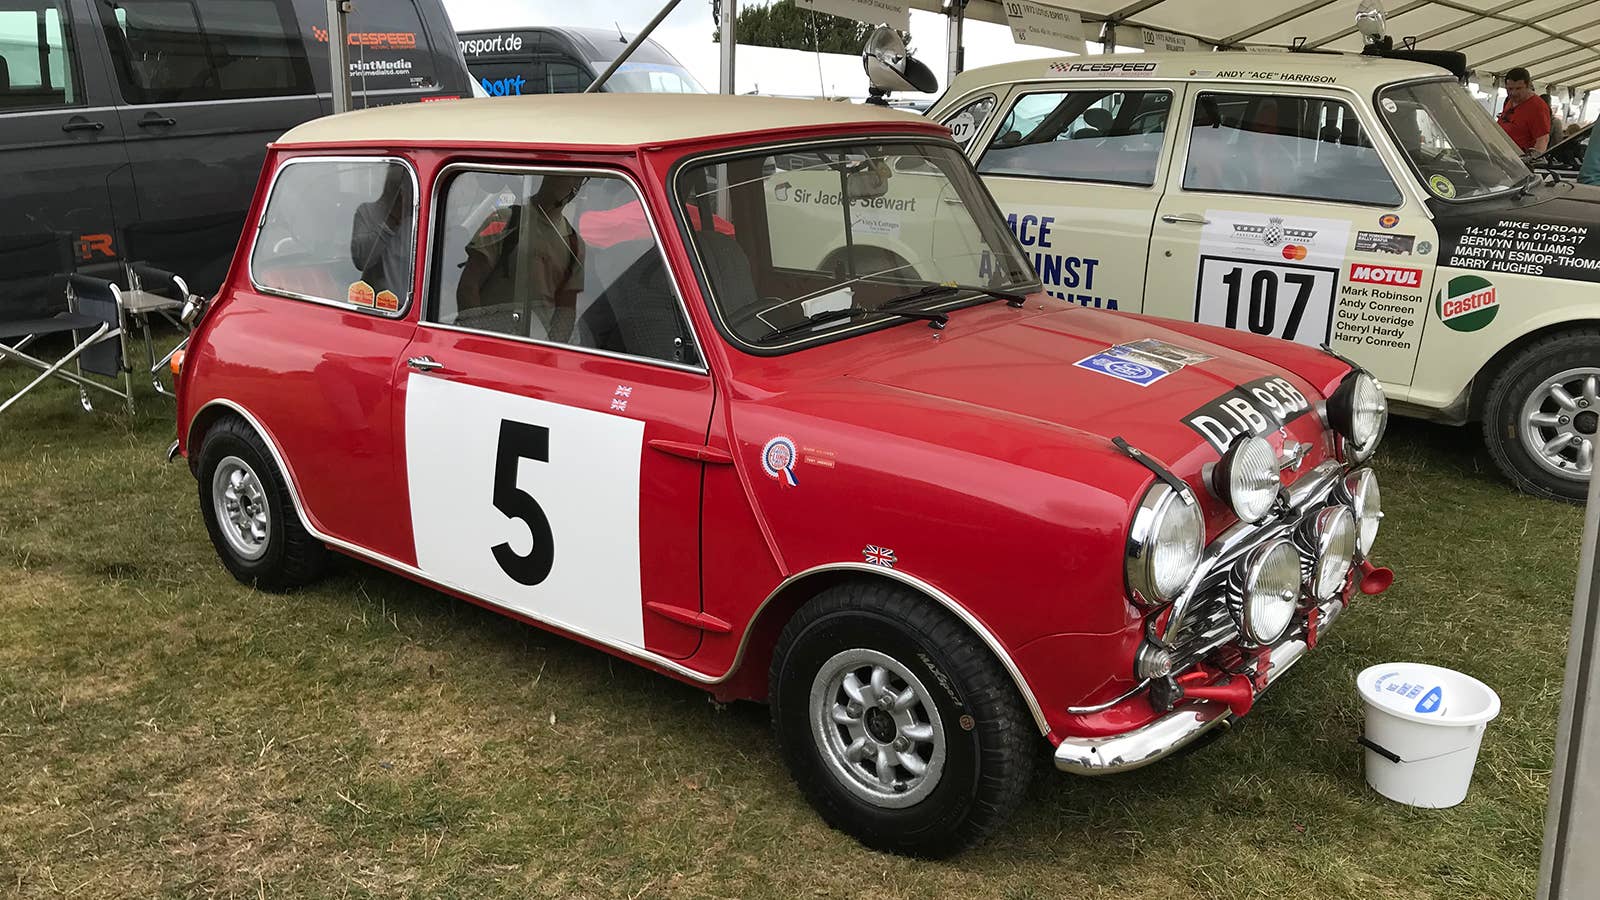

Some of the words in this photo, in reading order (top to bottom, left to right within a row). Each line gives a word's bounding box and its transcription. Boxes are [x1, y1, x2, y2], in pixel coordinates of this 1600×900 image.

[1007, 2, 1022, 15] 101
[347, 32, 416, 46] CESPEED
[459, 33, 522, 56] orsport.de
[350, 58, 412, 71] rintMedia
[1069, 62, 1157, 72] ACESPEED
[481, 75, 526, 97] port
[1216, 70, 1245, 78] ANDY
[1248, 71, 1279, 80] "ACE"
[1280, 73, 1337, 84] HARRISON
[950, 123, 969, 136] 07
[794, 188, 812, 203] Sir
[814, 190, 857, 206] Jacke
[860, 197, 917, 212] Stewart
[1006, 212, 1056, 249] ACE
[1465, 226, 1515, 239] 14-10-42
[1518, 231, 1530, 240] to
[1533, 233, 1586, 245] 01-03-17
[1498, 220, 1530, 230] MIKE
[1533, 223, 1588, 235] JORDAN
[1460, 235, 1512, 249] BERWYN
[1516, 240, 1575, 256] WILLIAMS
[1450, 256, 1490, 269] BARRY
[1491, 261, 1544, 275] HUGHES
[1455, 246, 1506, 260] MARTYN
[1508, 251, 1600, 270] ESMOR-THOMA
[1352, 267, 1418, 285] MOTUL
[1222, 266, 1316, 341] 107
[1342, 286, 1369, 297] Mark
[1371, 289, 1423, 303] Robinson
[1443, 287, 1497, 318] Castrol
[1339, 298, 1366, 310] Andy
[1369, 301, 1415, 315] Conreen
[1338, 309, 1359, 321] Guy
[1361, 312, 1415, 327] Loveridge
[1336, 321, 1370, 334] Cheryl
[1372, 325, 1405, 339] Hardy
[1334, 332, 1363, 345] Harry
[1366, 336, 1411, 350] Conreen
[1190, 397, 1268, 453] DJB
[1252, 377, 1309, 420] 93B
[491, 418, 555, 586] 5
